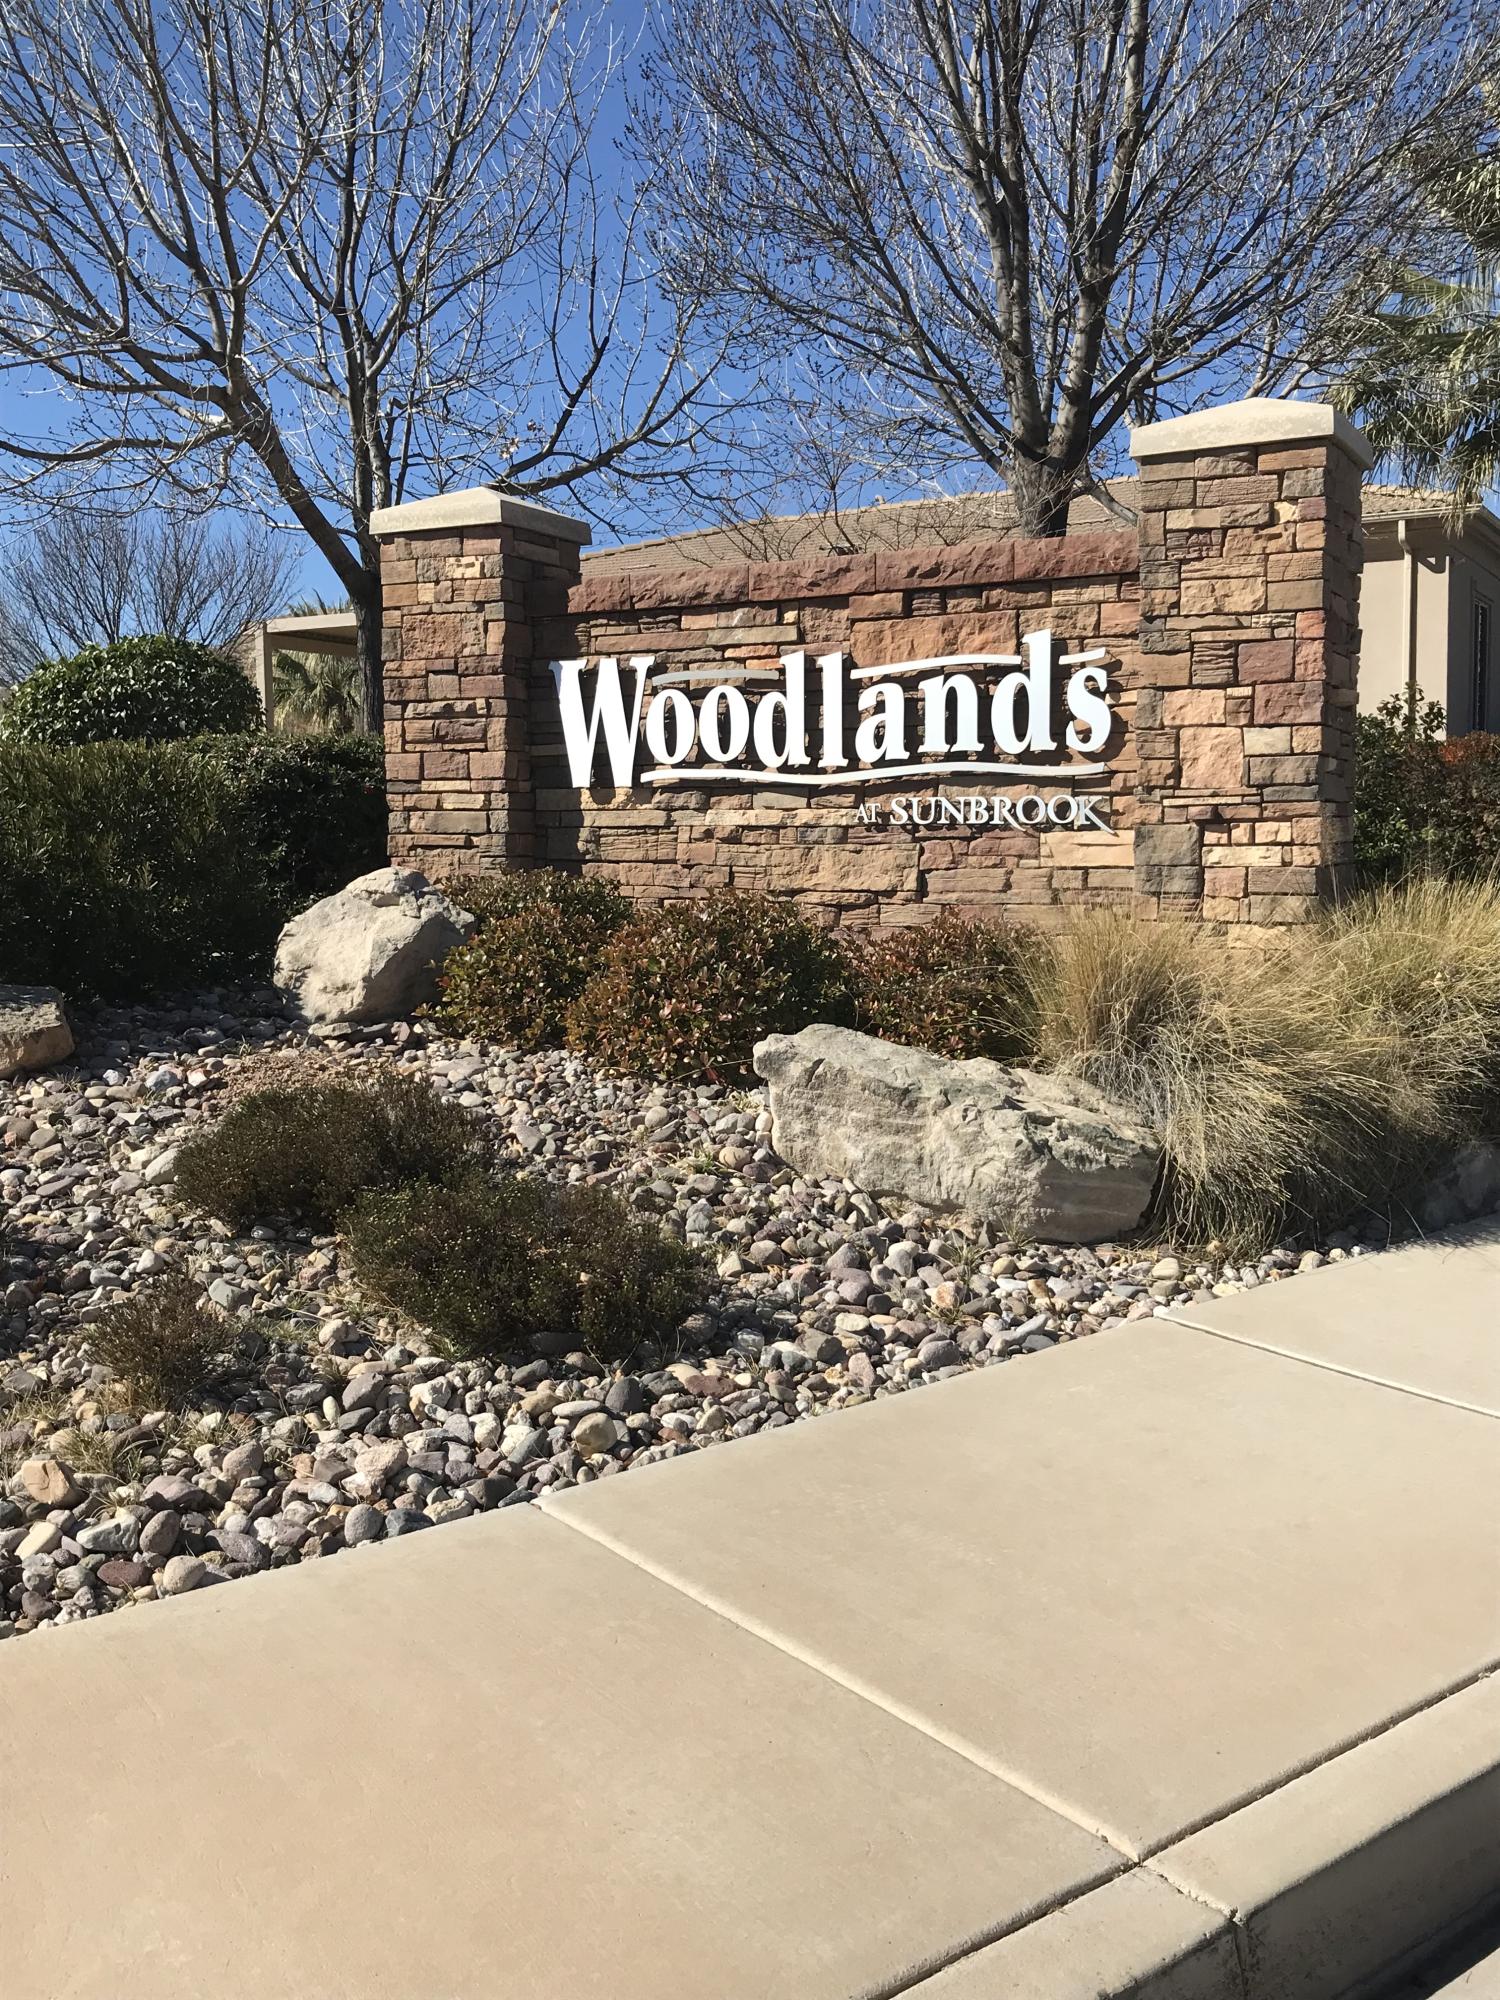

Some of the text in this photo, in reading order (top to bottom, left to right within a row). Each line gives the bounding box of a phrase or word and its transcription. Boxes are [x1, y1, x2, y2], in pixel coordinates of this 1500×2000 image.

[548, 628, 1112, 789] Woodlands
[854, 794, 1119, 837] AT SUNBROOK
